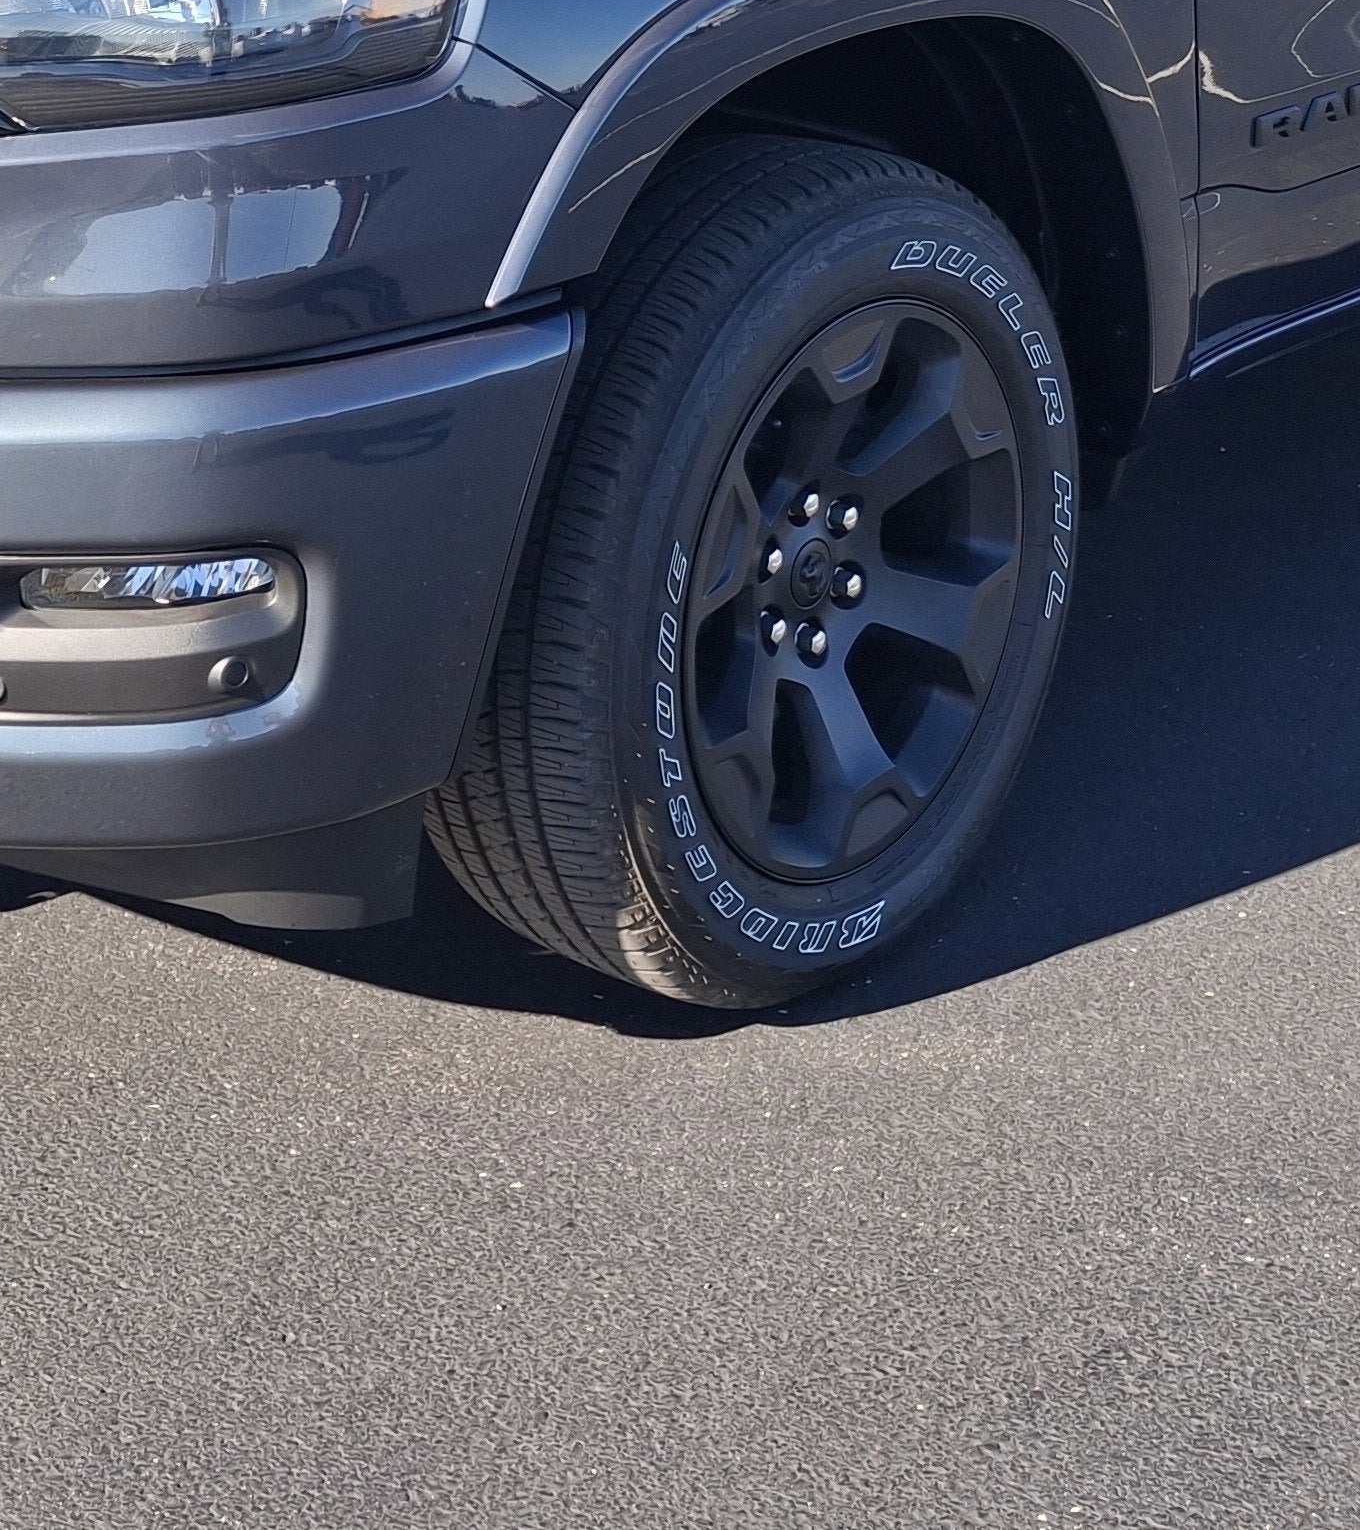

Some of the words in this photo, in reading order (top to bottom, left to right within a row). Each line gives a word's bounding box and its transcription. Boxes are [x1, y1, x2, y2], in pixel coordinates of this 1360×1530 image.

[890, 240, 1065, 426] DUELER
[1044, 470, 1072, 620] H/L
[655, 539, 886, 954] BRIDGESTONE
